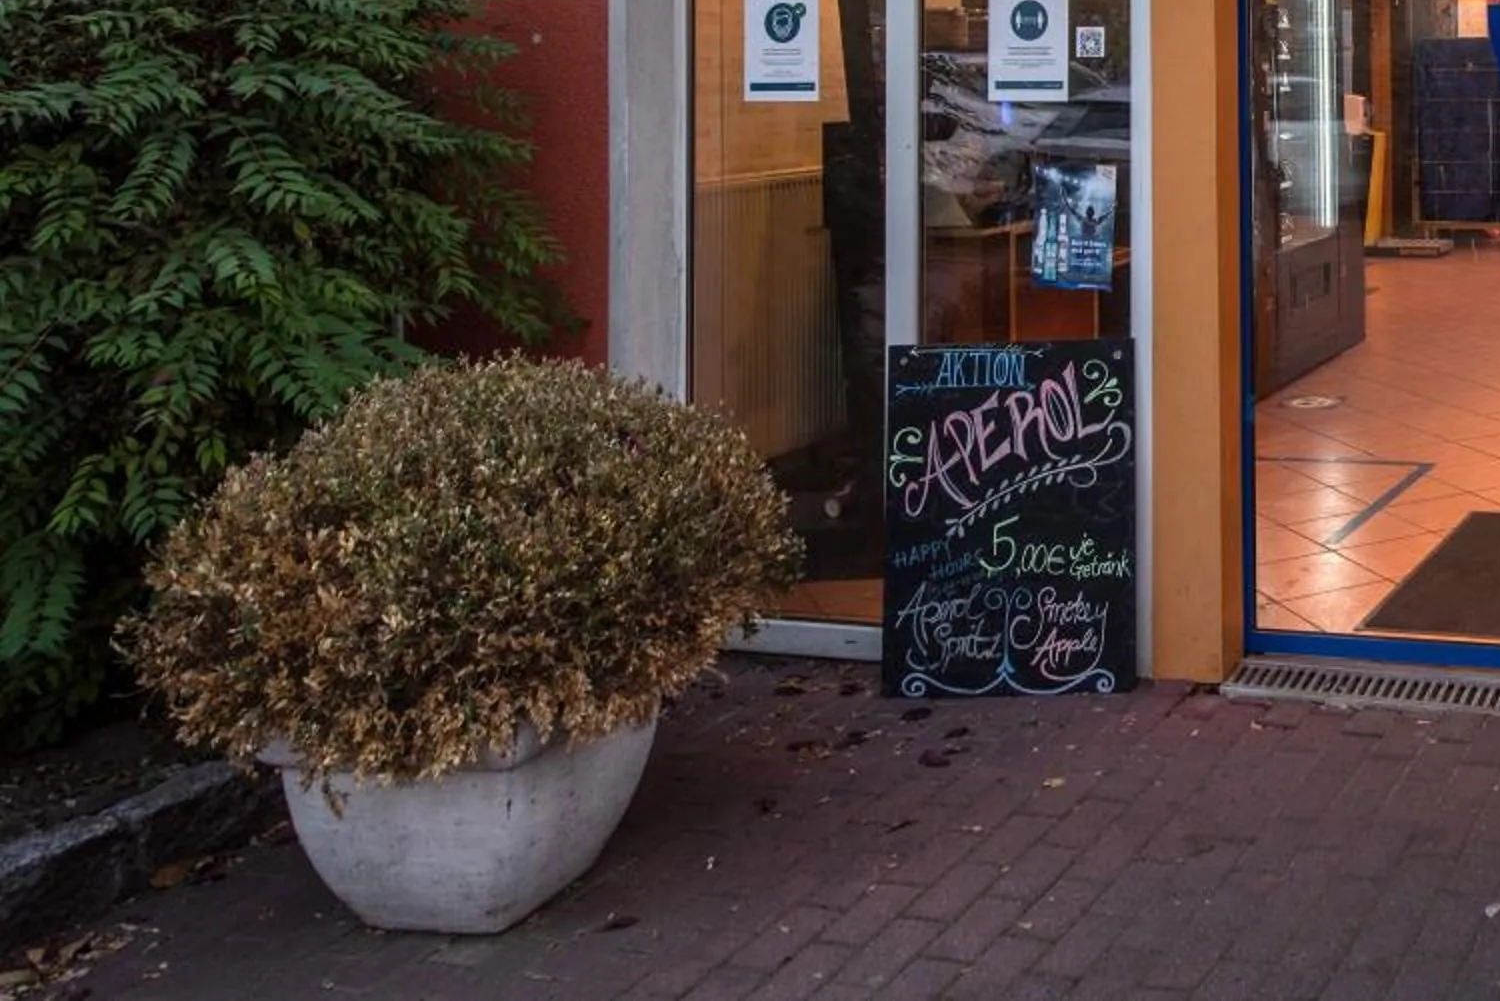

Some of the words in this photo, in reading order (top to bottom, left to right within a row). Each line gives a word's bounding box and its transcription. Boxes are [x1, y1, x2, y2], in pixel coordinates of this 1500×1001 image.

[937, 352, 1026, 387] AKTION
[905, 360, 1114, 517] APEROL
[893, 537, 952, 569] HAPPY
[979, 516, 1066, 578] 5,00€
[896, 582, 986, 653] Aperol
[1016, 586, 1109, 645] Smokey
[909, 619, 1001, 673] Spritz
[1030, 626, 1100, 668] Apple
